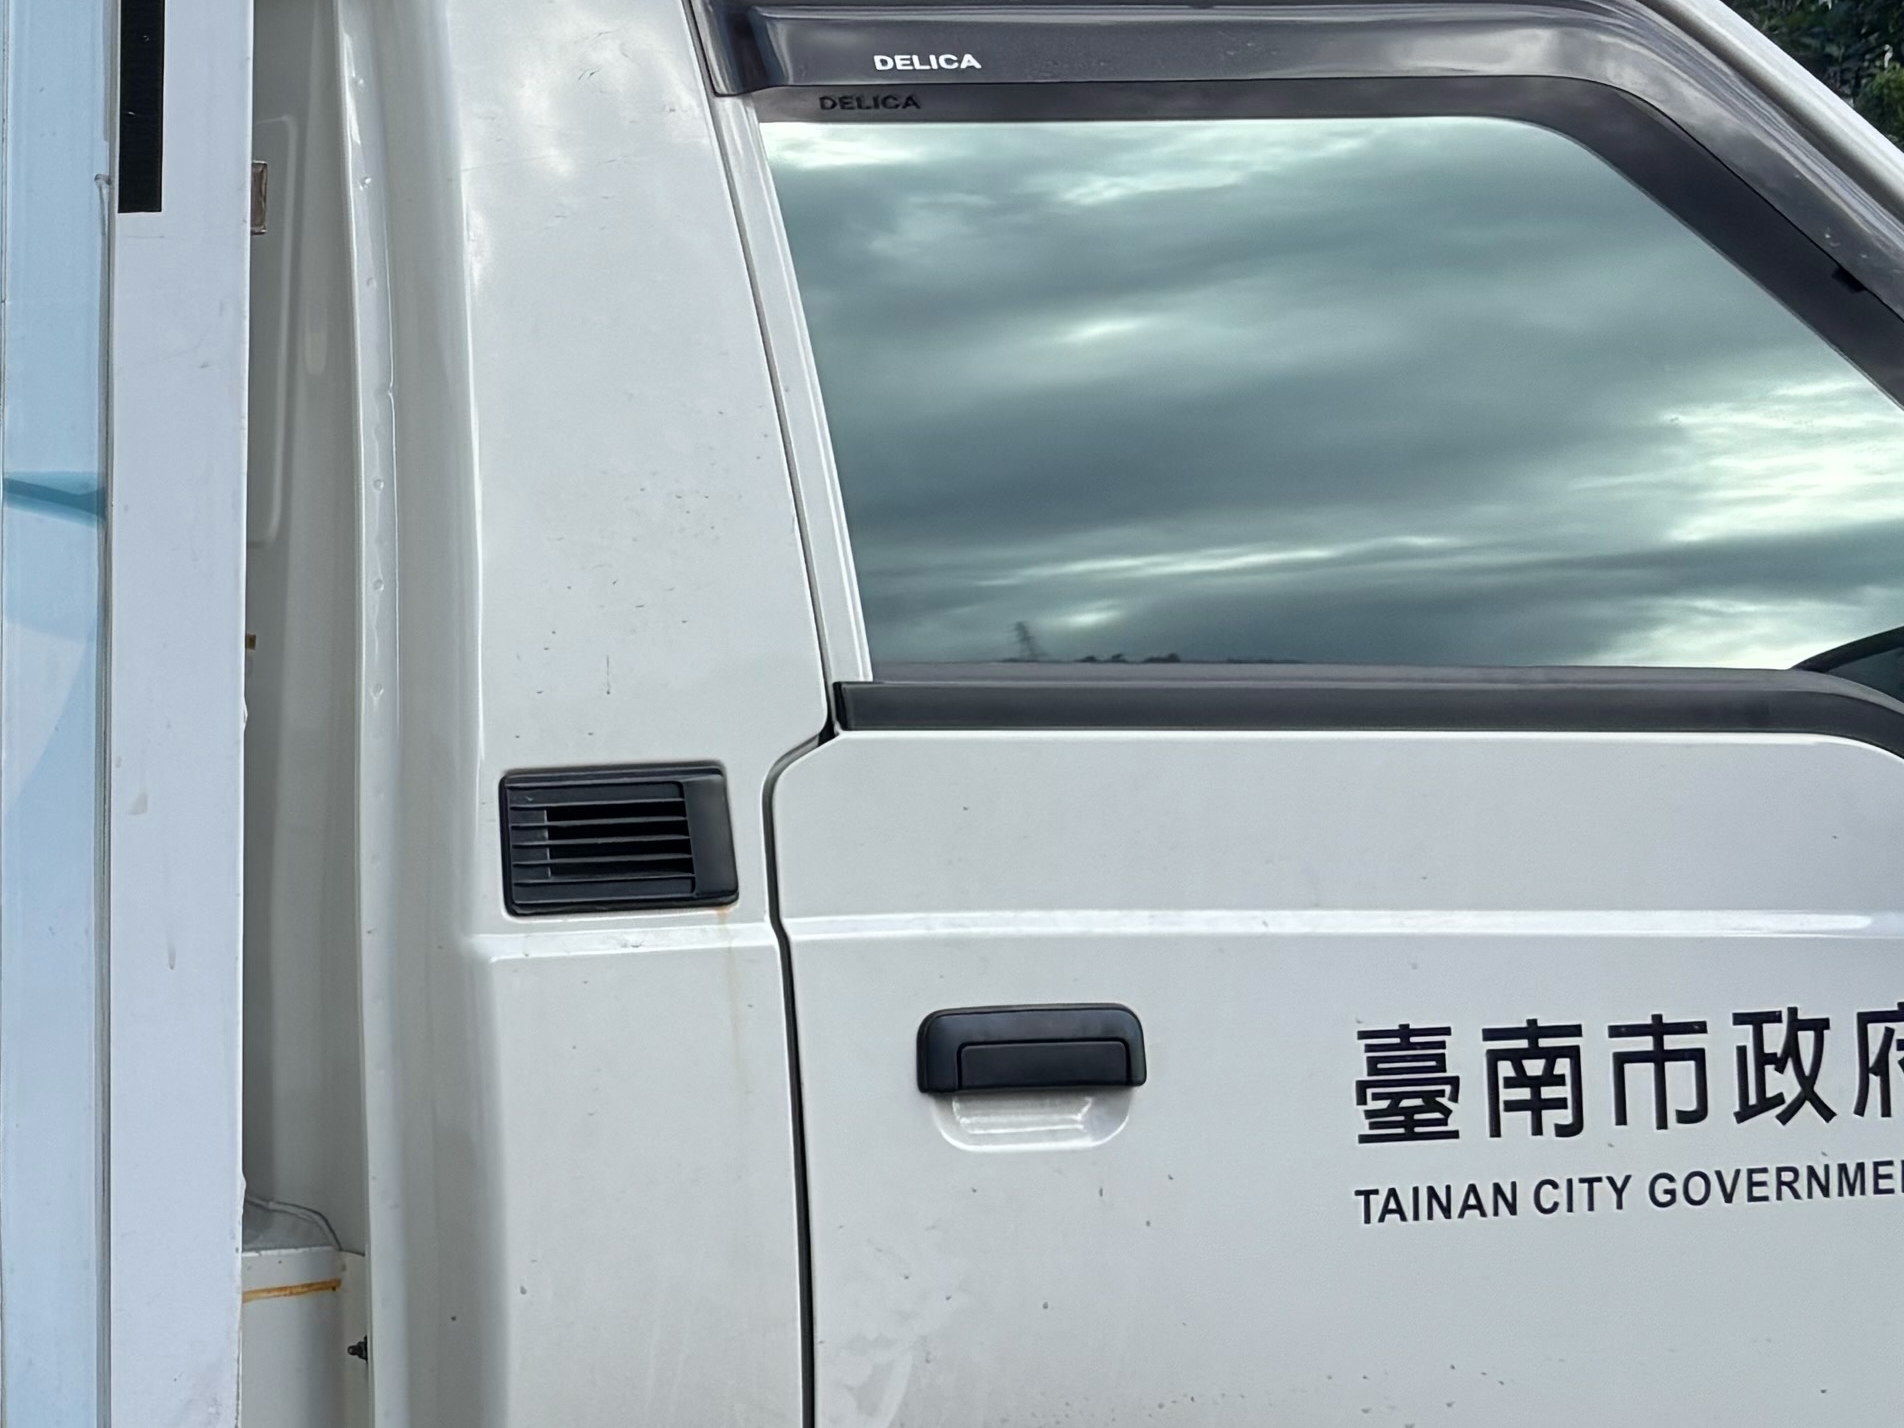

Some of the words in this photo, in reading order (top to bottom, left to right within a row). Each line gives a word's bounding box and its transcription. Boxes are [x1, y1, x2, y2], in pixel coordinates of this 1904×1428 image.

[873, 53, 982, 71] DELICA
[1354, 1181, 1518, 1225] TAINAN
[1534, 1175, 1632, 1215] CITY
[1648, 1159, 1904, 1210] GOVERNME
